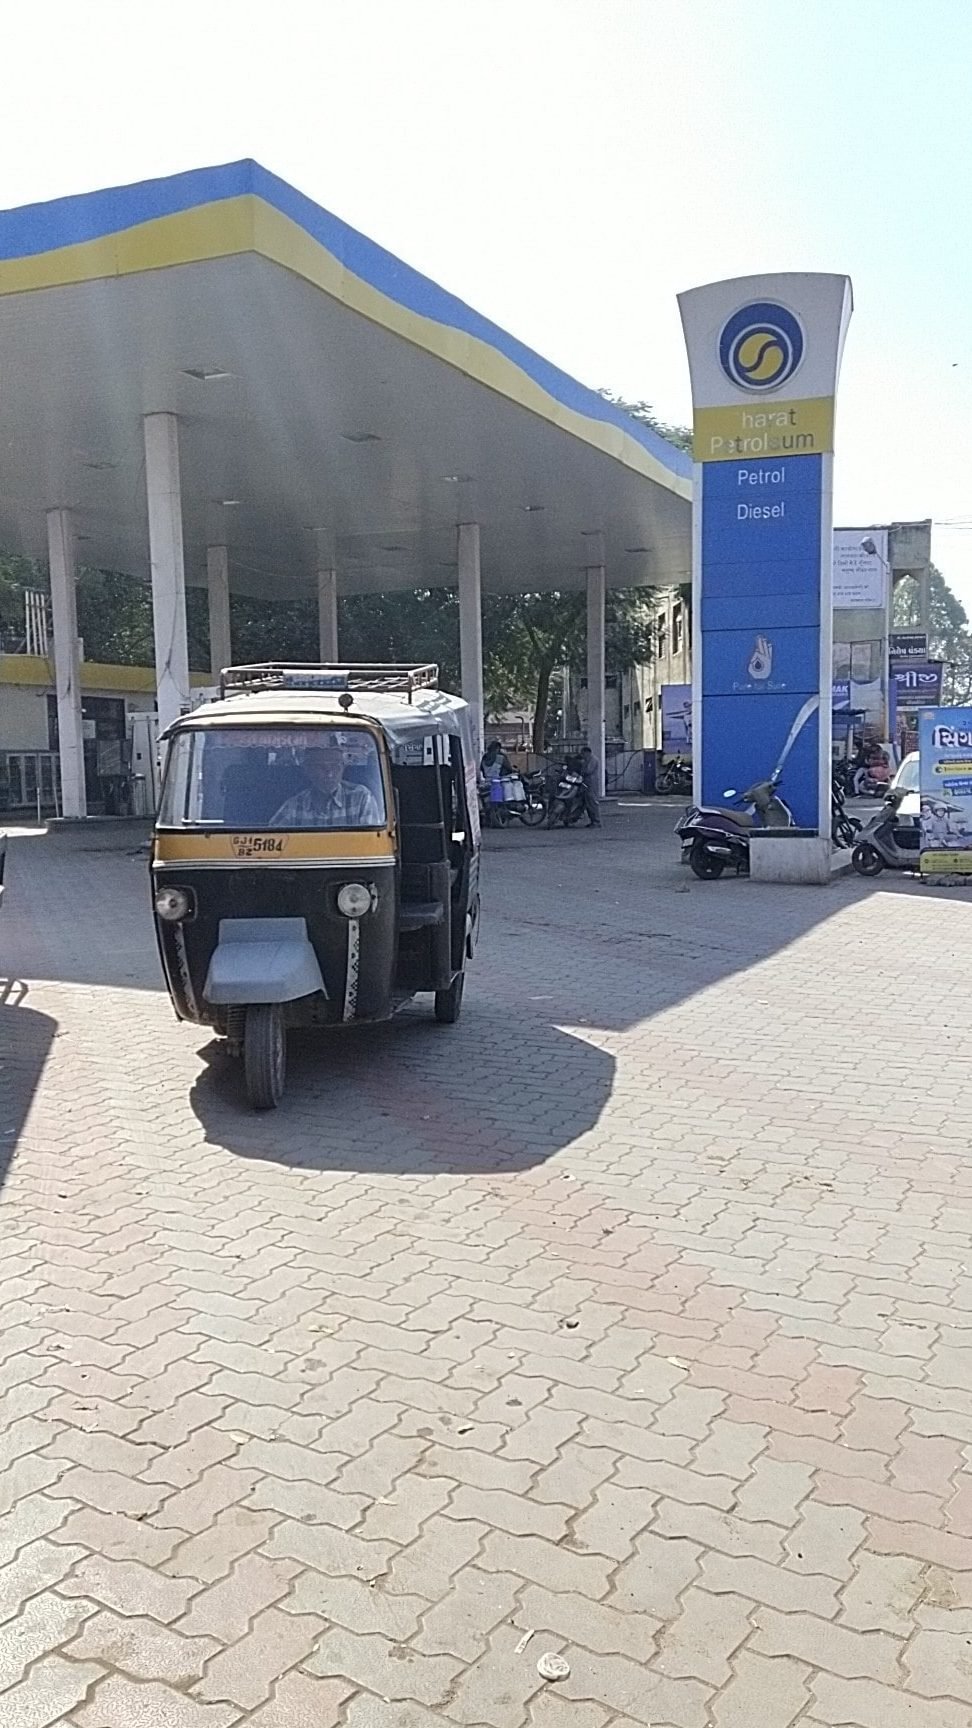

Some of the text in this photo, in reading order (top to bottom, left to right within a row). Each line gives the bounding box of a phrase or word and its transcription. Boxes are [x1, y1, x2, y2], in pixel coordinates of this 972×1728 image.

[710, 432, 815, 454] Petrolum
[738, 467, 785, 485] Petrol
[737, 502, 785, 520] Diesel
[253, 838, 283, 852] 5184
